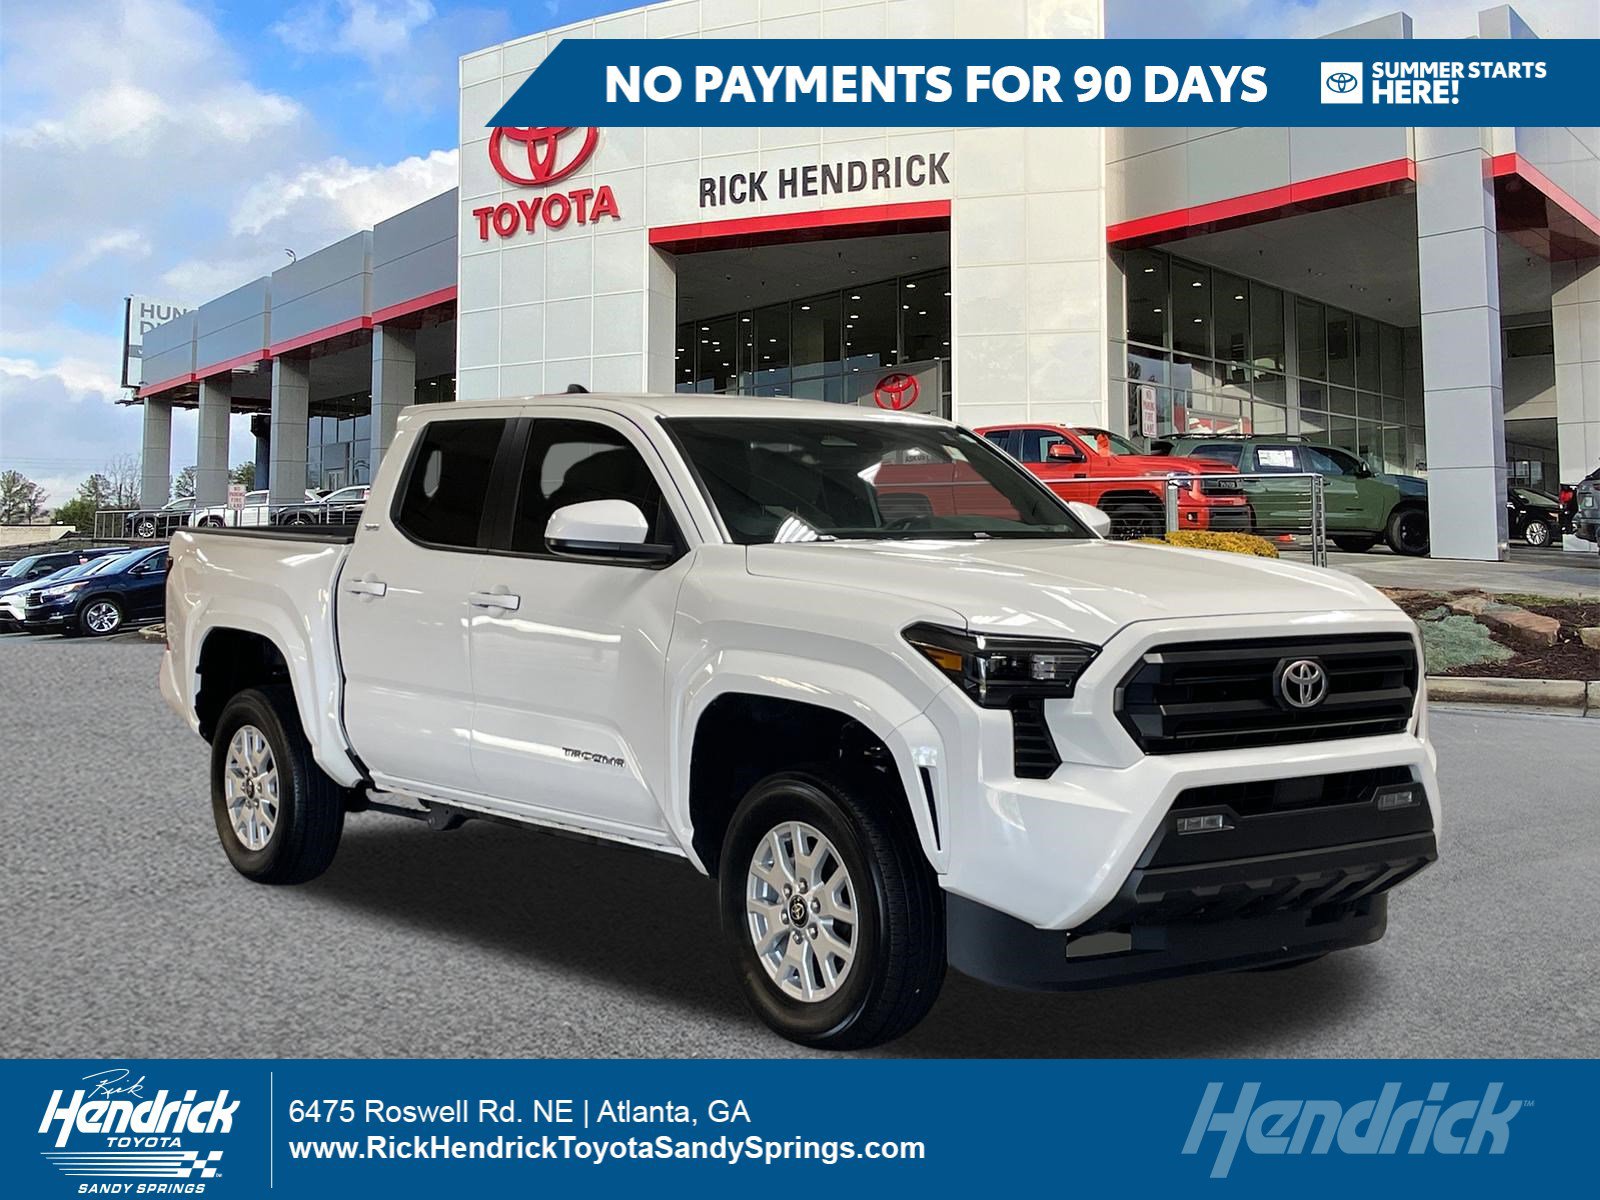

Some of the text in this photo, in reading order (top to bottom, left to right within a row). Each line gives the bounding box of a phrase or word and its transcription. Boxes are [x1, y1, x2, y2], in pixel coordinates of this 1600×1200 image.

[699, 152, 950, 208] RICK HENDRICK
[473, 185, 620, 240] TOYOTA
[562, 746, 625, 767] TACOMA
